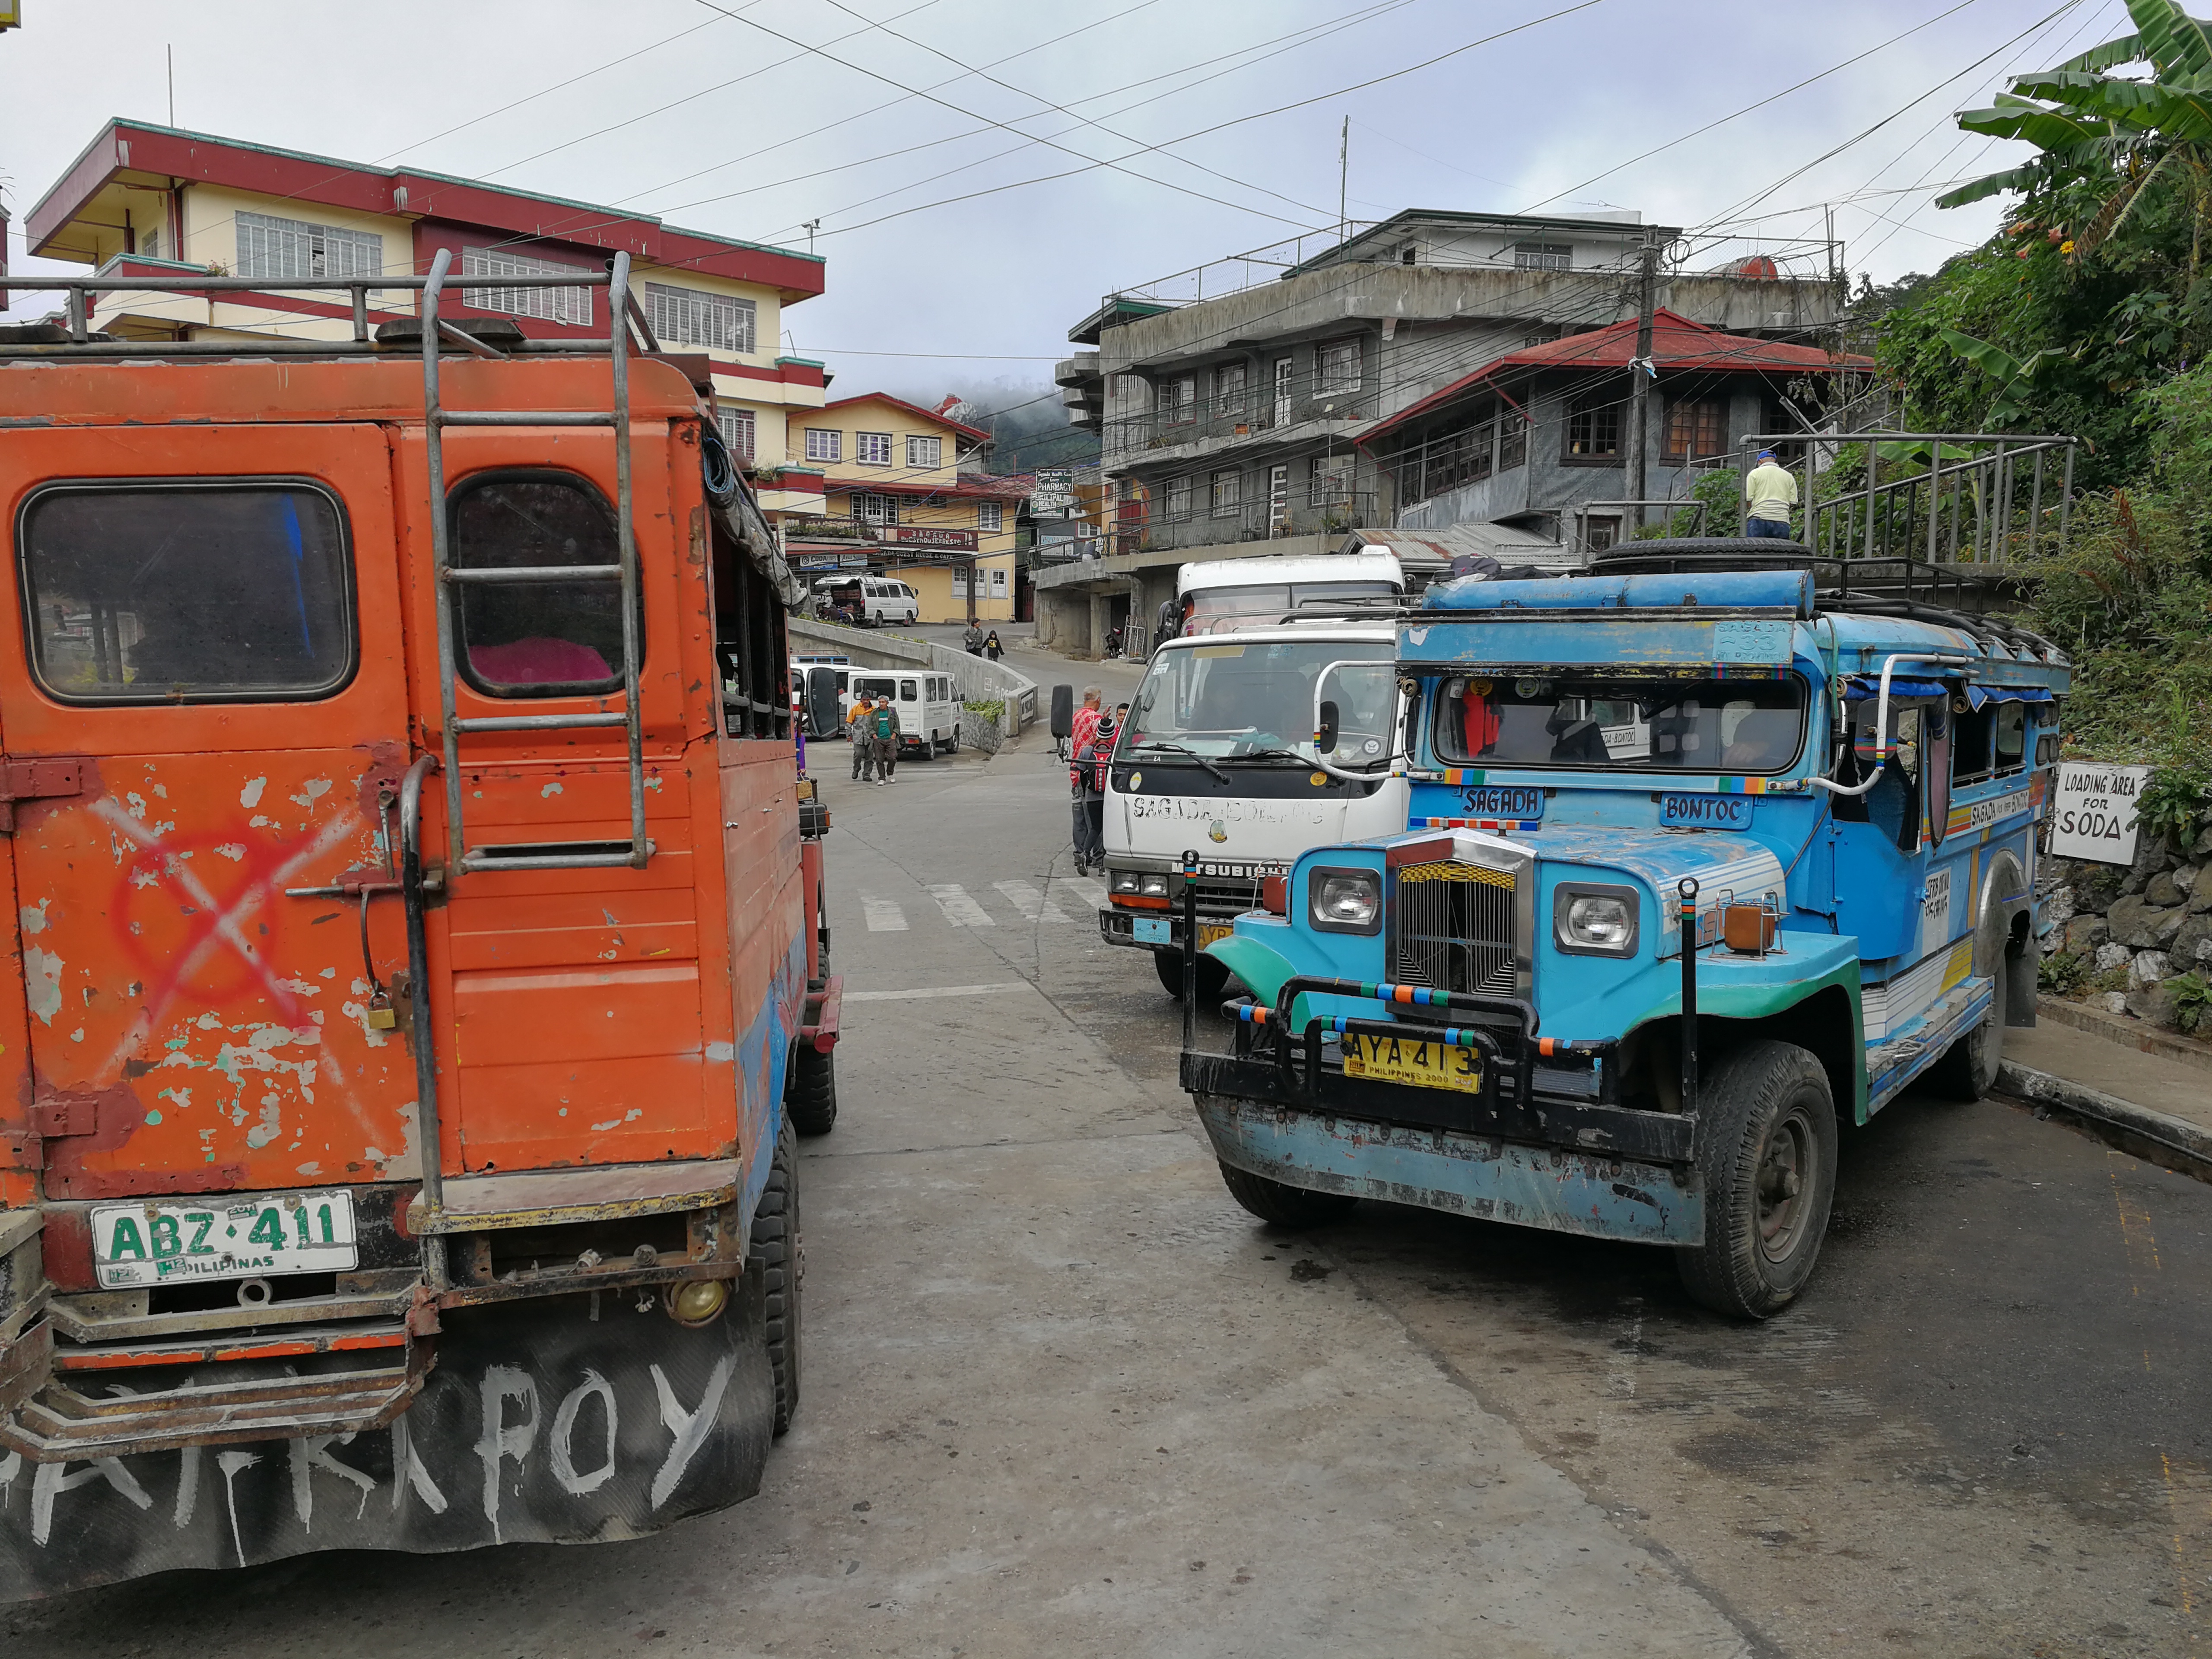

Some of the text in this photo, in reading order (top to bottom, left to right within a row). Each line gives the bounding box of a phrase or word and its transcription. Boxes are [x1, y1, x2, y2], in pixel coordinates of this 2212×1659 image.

[1037, 482, 1071, 491] PHARMACY
[2065, 773, 2135, 797] LOADING AREA
[1462, 789, 1538, 814] SAGADA
[1666, 797, 1743, 821] BONTOC
[2083, 798, 2108, 810] FOR
[1972, 802, 1996, 826] SAGADA
[2059, 810, 2121, 840] SODA
[1172, 863, 1287, 878] MTSUBISHI
[1369, 1065, 1422, 1080] PHILIPPINES
[474, 1354, 738, 1543] POY
